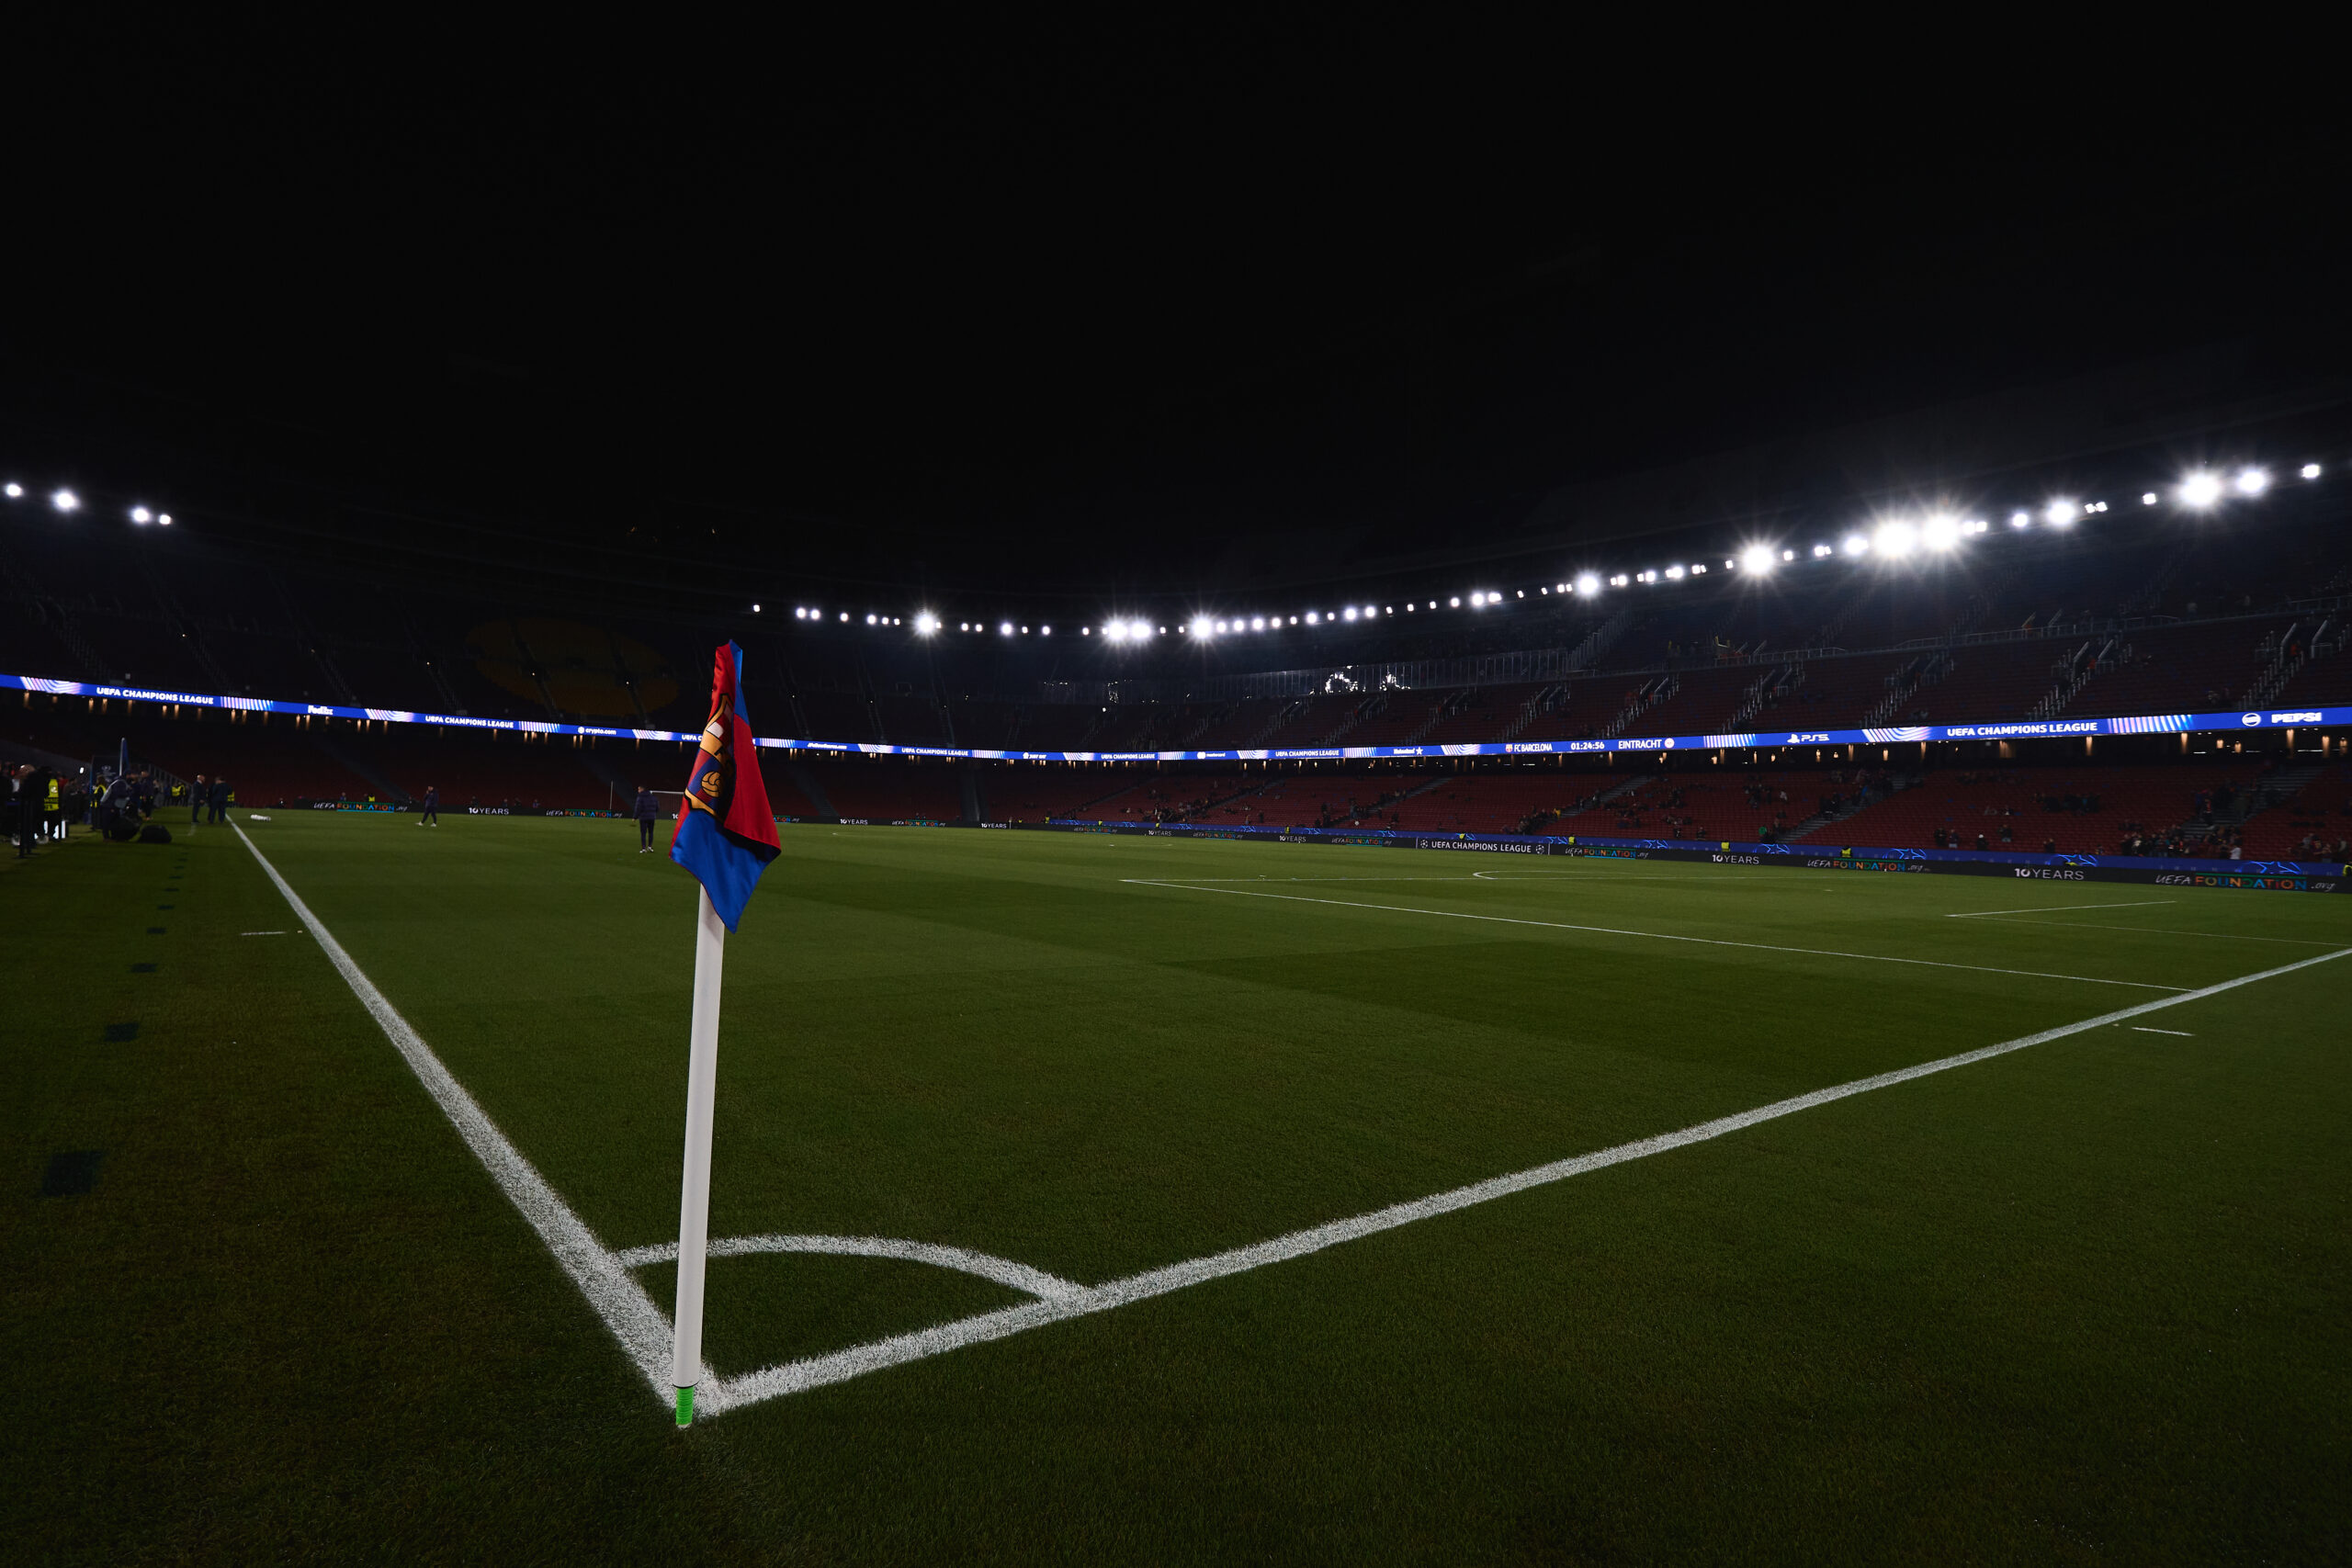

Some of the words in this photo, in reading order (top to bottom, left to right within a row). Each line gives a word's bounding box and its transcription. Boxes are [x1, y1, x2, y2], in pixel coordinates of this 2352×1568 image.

[96, 687, 120, 696] UEFA
[122, 690, 178, 702] CHAMPIONS
[179, 694, 214, 705] LEAGUE
[445, 716, 487, 727] CHAMPIONS
[488, 720, 514, 728] LEAGUE
[2271, 712, 2323, 724] PEPSI
[1947, 728, 1975, 737] UEFA
[1977, 724, 2048, 735] CHAMPIONS
[2049, 722, 2098, 733] LEAGUE
[1801, 733, 1830, 742] PS5
[1514, 744, 1521, 752] FC
[1521, 742, 1553, 752] BARCELONA
[1570, 741, 1605, 750] 01:24:56
[1618, 739, 1662, 750] EINTRACHT
[1431, 840, 1451, 849] UEFA
[1452, 841, 1498, 852] CHAMPIONS
[1500, 844, 1532, 853] LEAGUE
[1807, 859, 1831, 867] UEFA
[1833, 859, 1906, 872] FOUNDATION
[2155, 874, 2191, 886] UEFA
[2195, 875, 2307, 890] FOUNDATION
